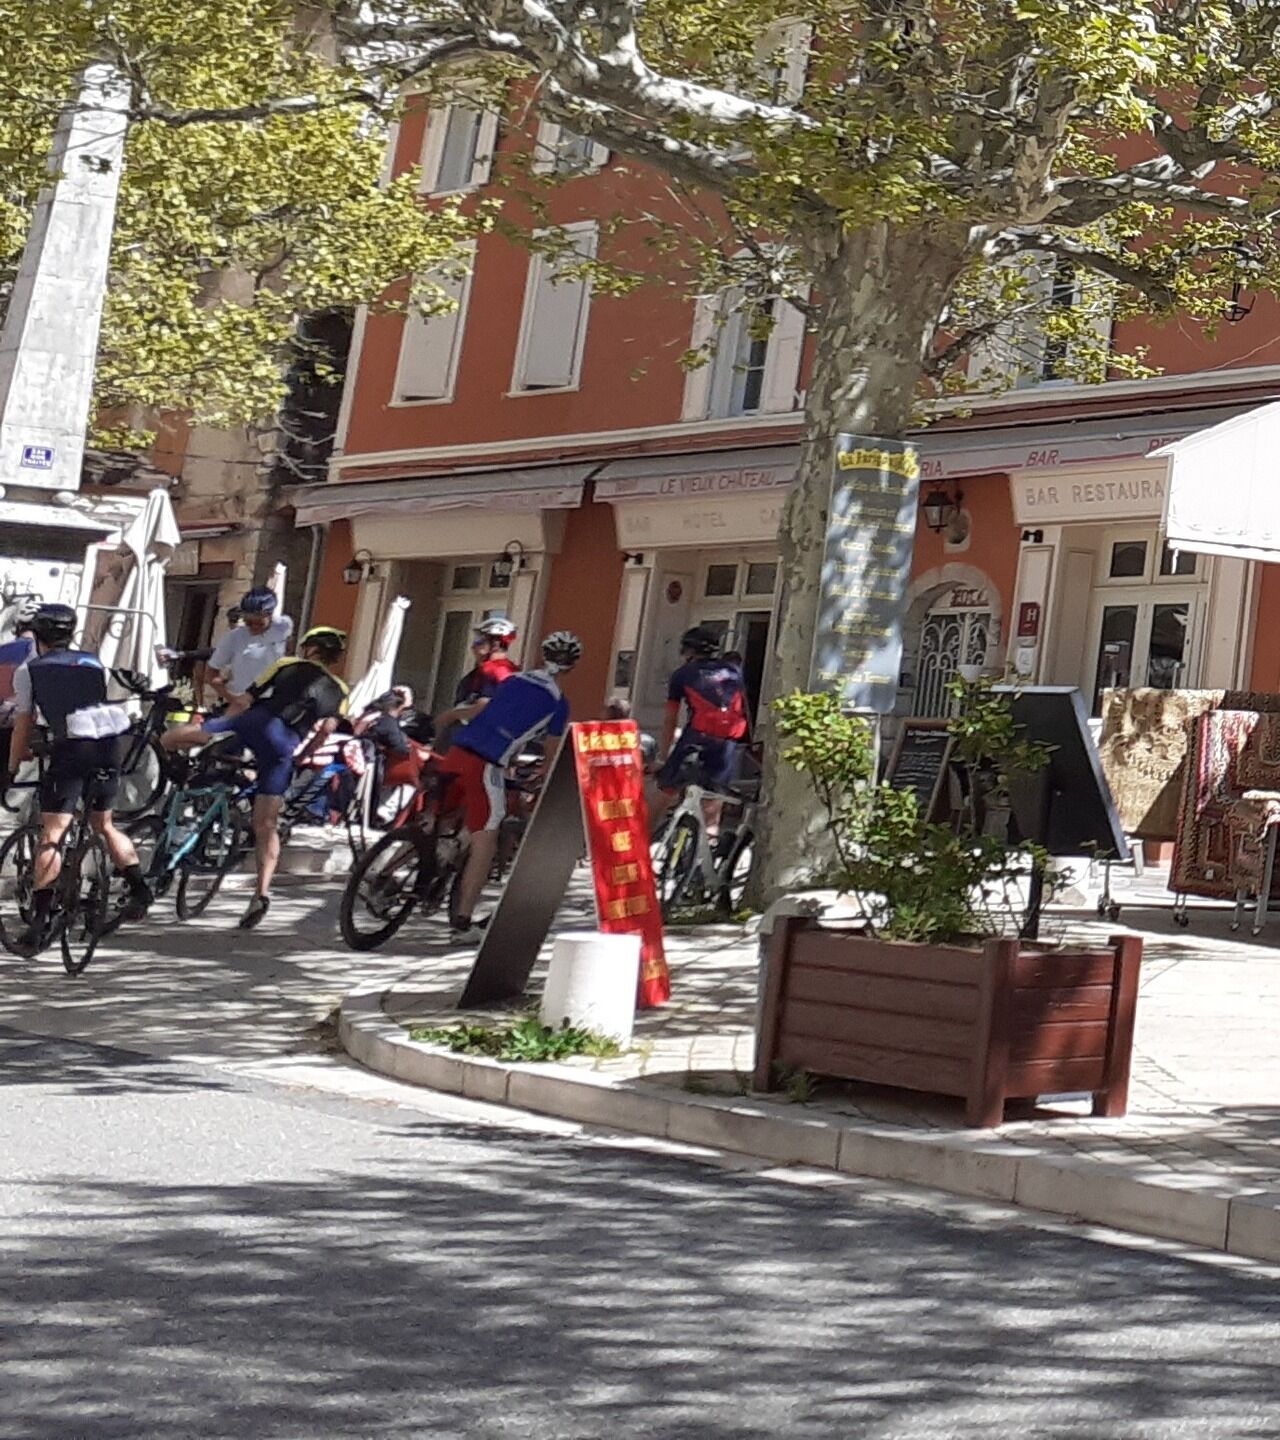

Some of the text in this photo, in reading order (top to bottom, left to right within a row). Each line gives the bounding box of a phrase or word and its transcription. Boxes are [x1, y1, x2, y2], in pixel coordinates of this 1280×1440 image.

[1026, 450, 1059, 467] BAR
[1026, 480, 1164, 506] BAR RESTAURA
